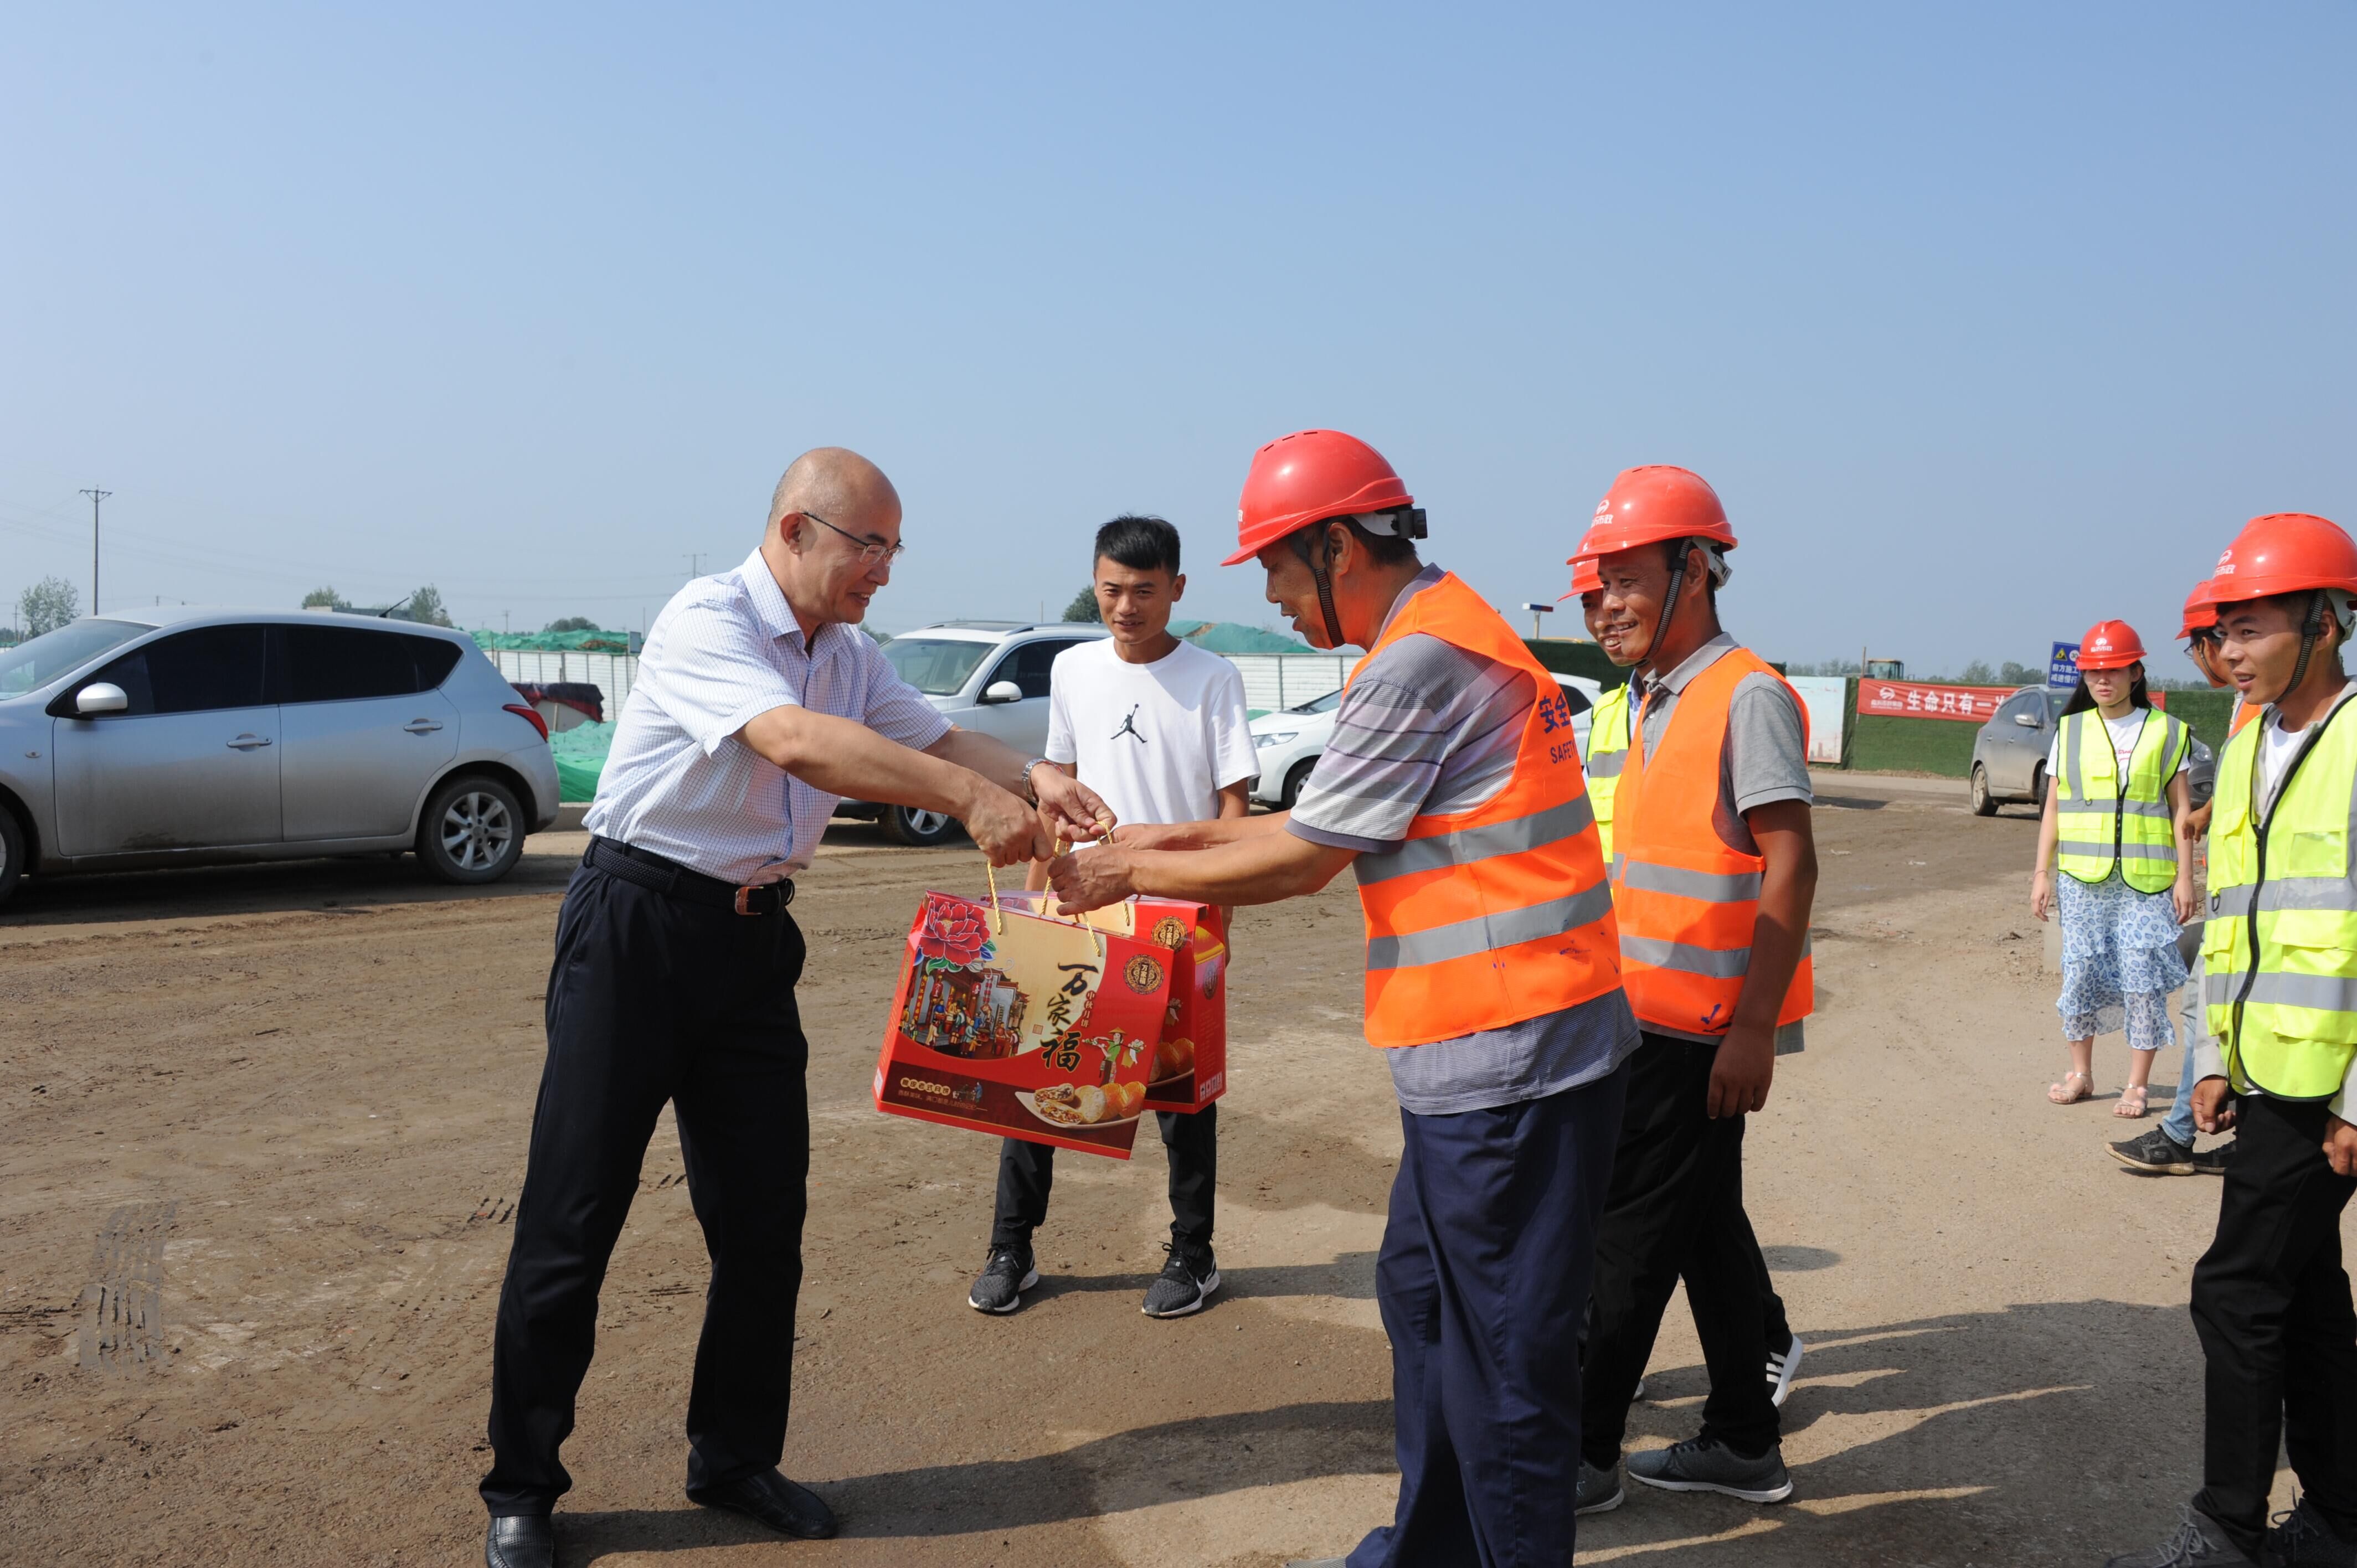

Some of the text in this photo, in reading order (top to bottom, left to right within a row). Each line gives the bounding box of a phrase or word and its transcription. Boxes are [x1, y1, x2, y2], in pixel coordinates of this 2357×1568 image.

[2052, 663, 2078, 674] 前方施工
[1539, 692, 1571, 734] 安全
[1041, 962, 1099, 1072] 万家福
[1080, 991, 1095, 1028] 中秋月饼
